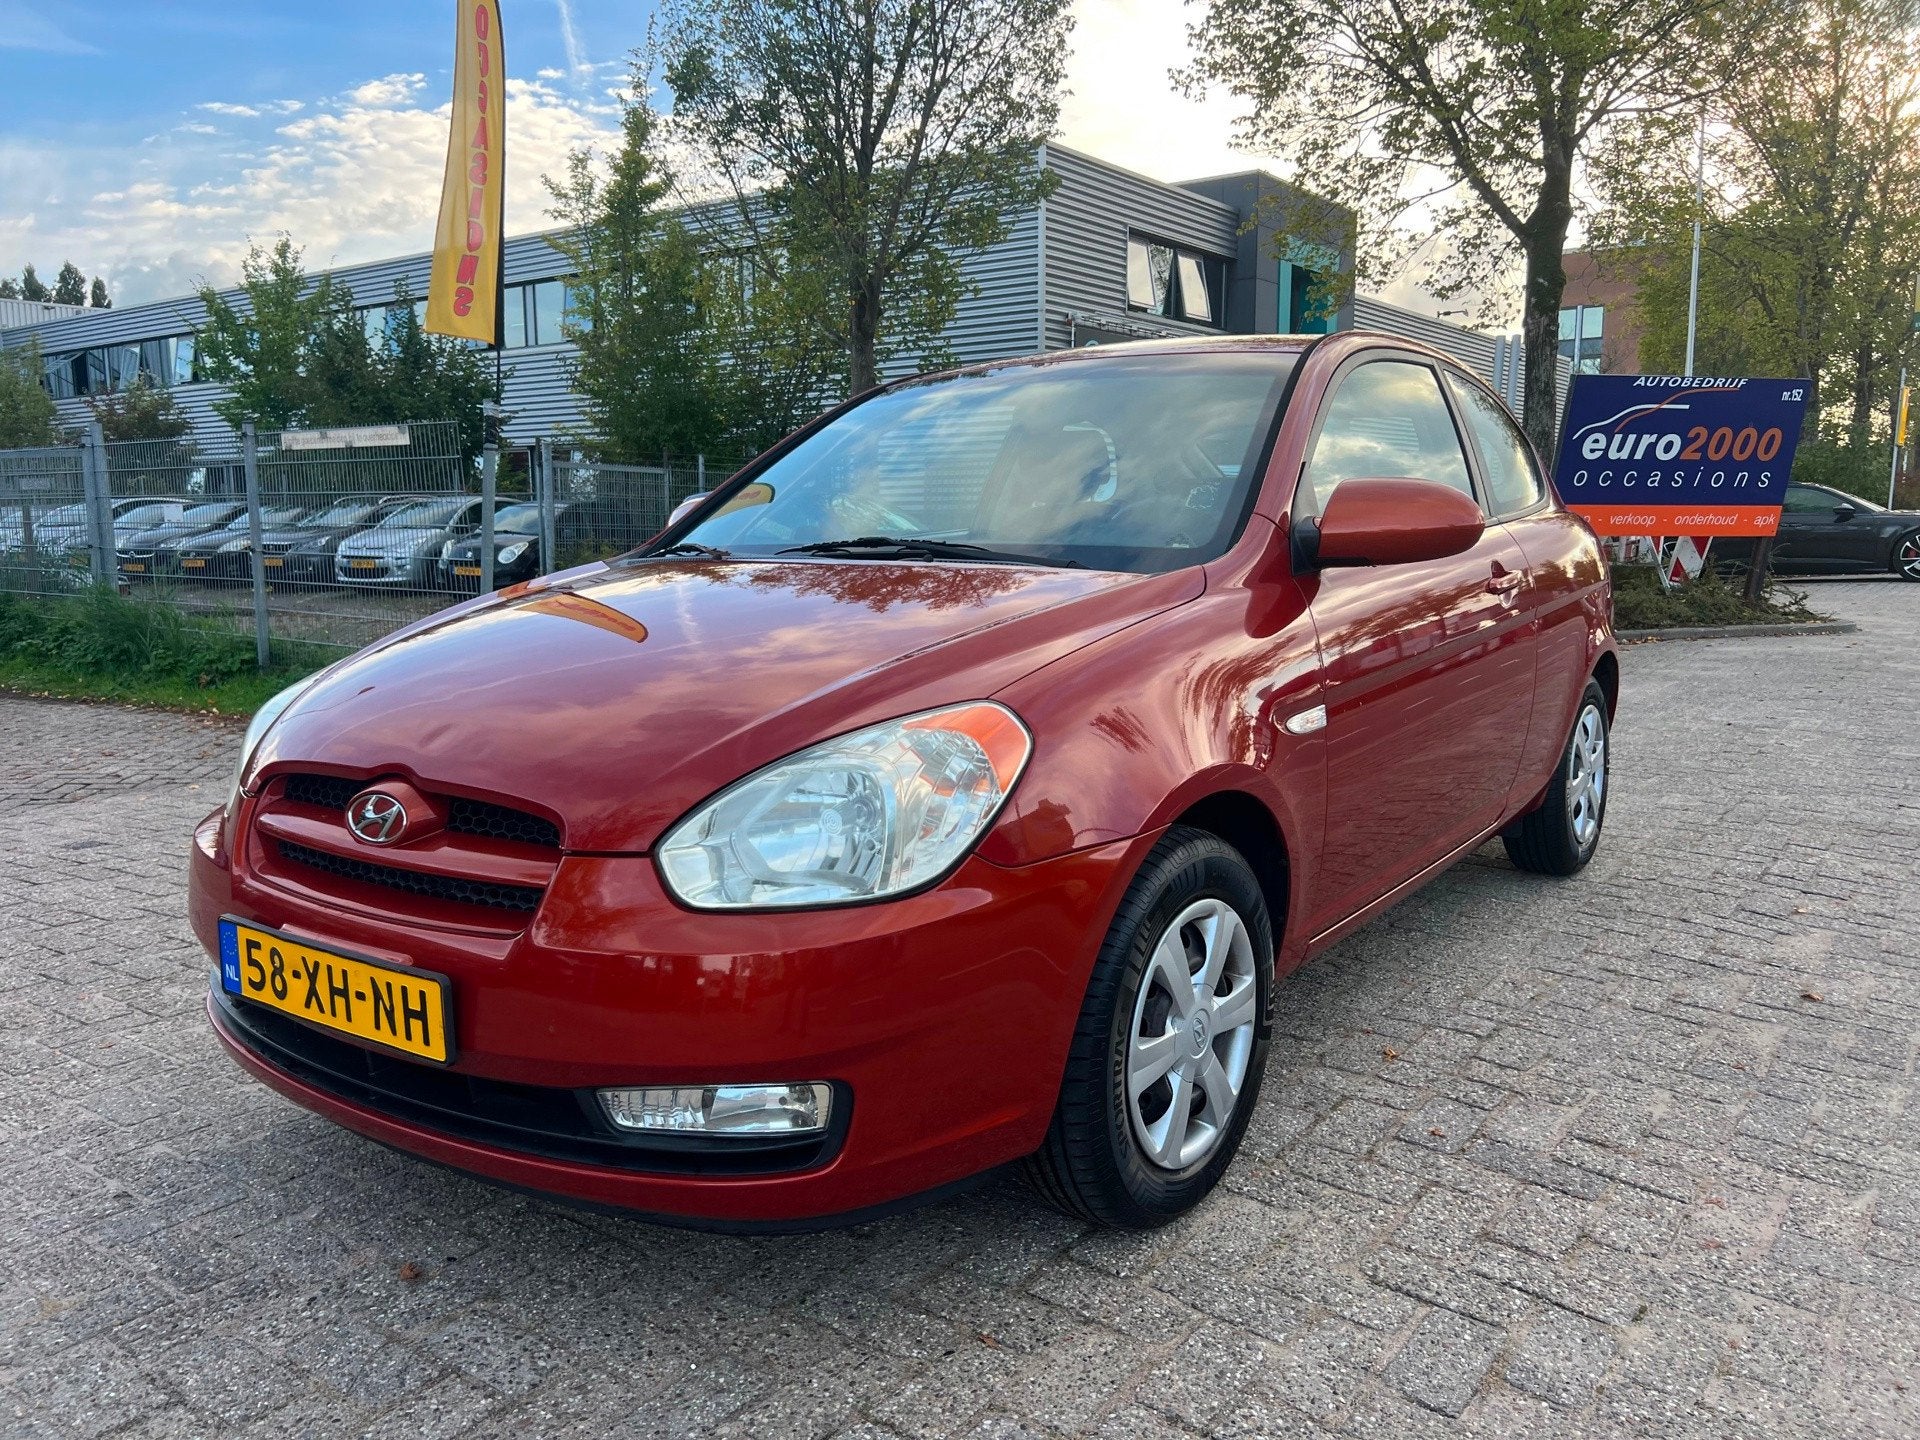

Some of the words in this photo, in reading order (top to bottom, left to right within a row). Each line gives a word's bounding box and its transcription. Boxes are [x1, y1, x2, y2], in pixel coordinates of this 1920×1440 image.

[1633, 376, 1749, 389] AUTOBEDRIJF
[1781, 388, 1803, 402] nr.152
[1581, 426, 1784, 462] euro2000
[1573, 467, 1772, 488] occasions
[1609, 513, 1656, 526] verkoop
[1674, 513, 1737, 526] onderhoud
[1753, 515, 1776, 527] apk
[225, 963, 239, 982] NL
[245, 938, 432, 1047] 58-XH-NH
